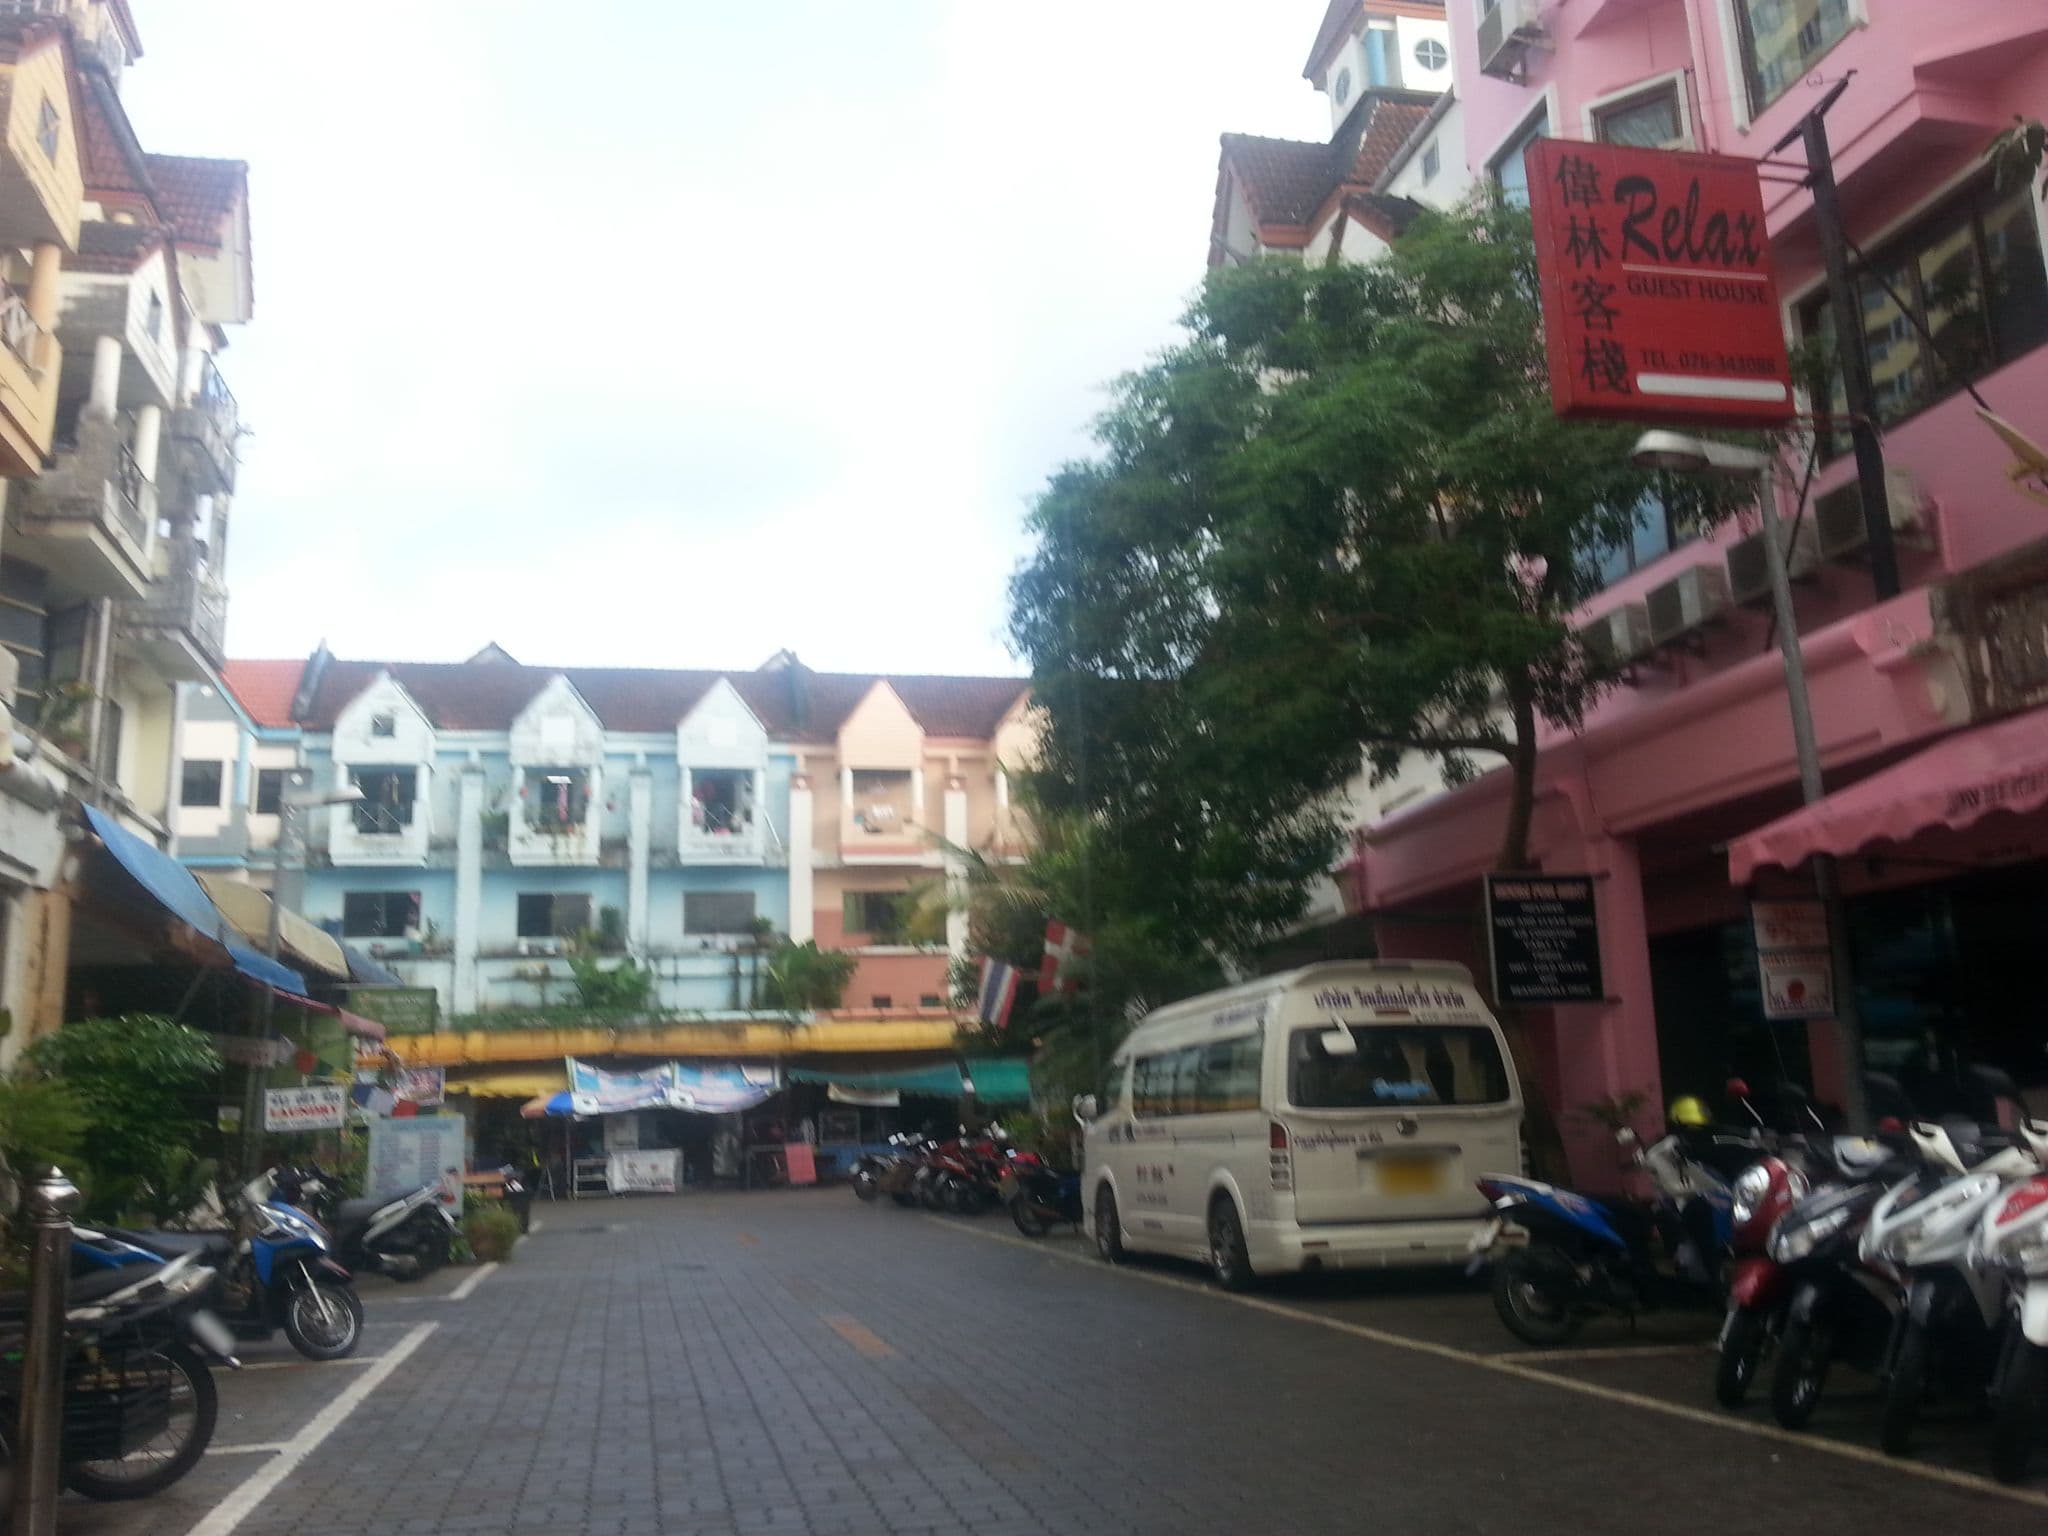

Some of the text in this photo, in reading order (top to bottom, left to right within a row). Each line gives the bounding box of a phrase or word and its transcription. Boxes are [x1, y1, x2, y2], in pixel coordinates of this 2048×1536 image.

[1613, 174, 1761, 267] Relax
[1626, 274, 1770, 305] GUEST HOUSE
